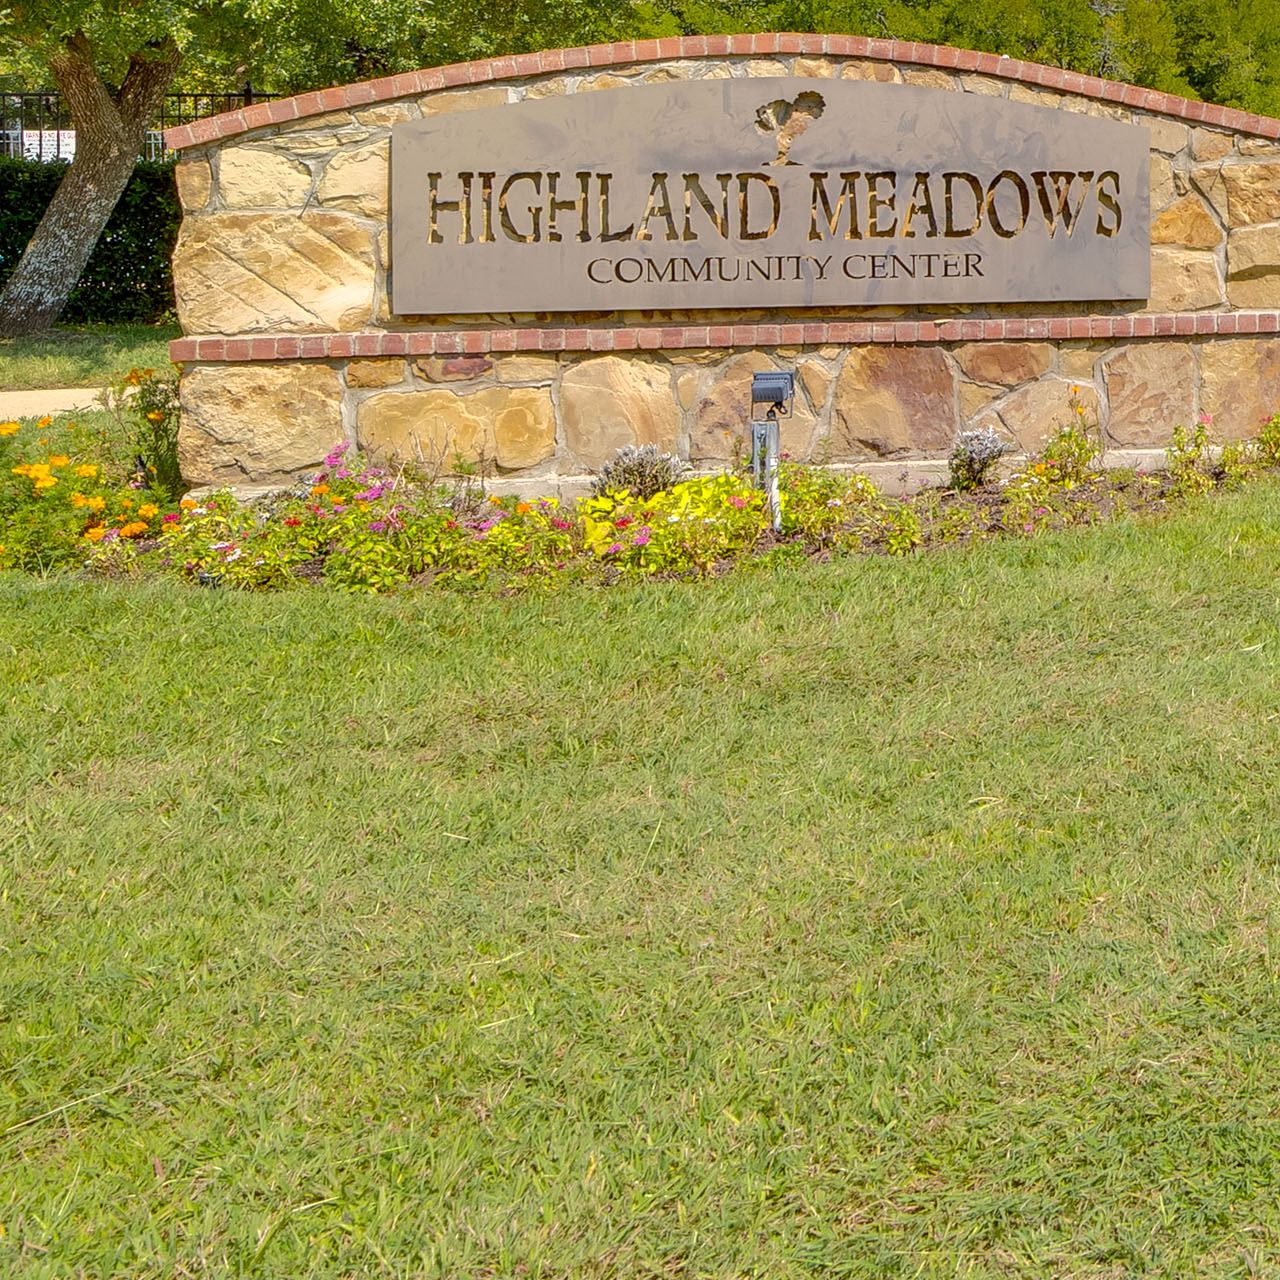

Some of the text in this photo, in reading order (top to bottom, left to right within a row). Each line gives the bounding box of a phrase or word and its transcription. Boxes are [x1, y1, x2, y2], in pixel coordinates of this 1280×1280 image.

[426, 170, 1122, 245] HIGHLAND MEADOWS
[587, 253, 985, 284] COMMUNITY CENTER
